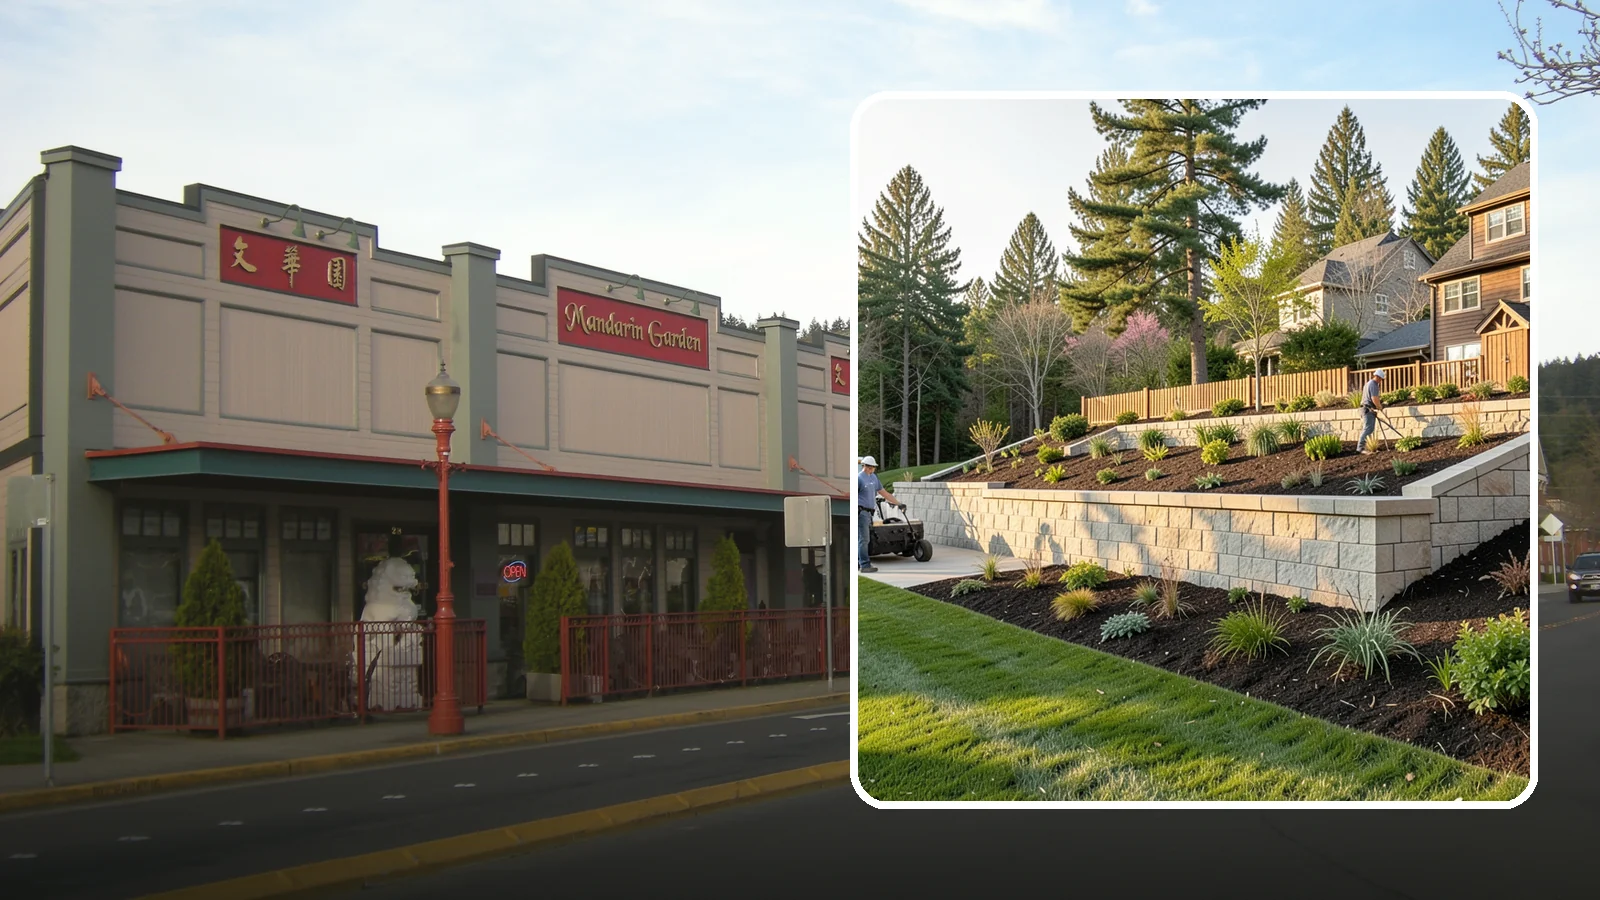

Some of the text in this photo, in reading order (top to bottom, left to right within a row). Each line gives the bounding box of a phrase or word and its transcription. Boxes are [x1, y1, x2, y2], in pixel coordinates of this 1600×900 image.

[564, 302, 702, 352] Mandarin Garden
[503, 565, 527, 578] OPEN
